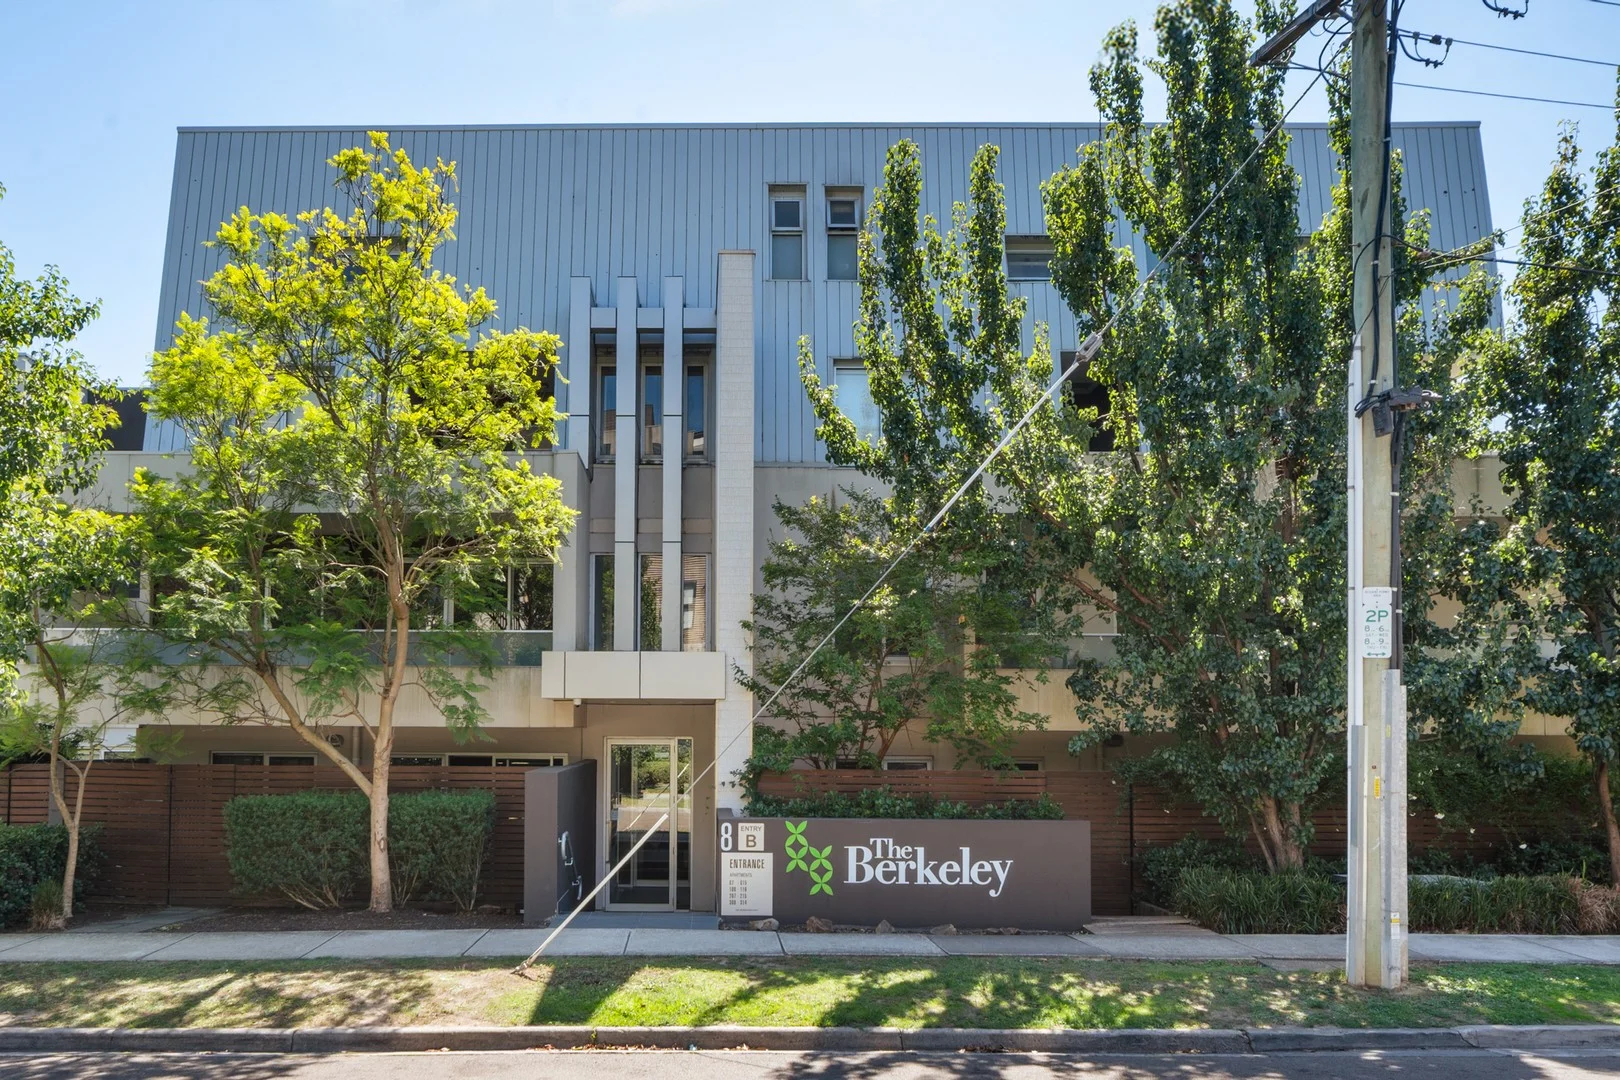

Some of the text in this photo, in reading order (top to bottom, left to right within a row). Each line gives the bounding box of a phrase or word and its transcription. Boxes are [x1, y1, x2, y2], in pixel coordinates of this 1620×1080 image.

[1366, 610, 1388, 622] 2P
[721, 822, 732, 851] 8
[746, 834, 757, 848] B
[870, 838, 913, 859] The
[729, 858, 765, 869] ENTRANCE
[843, 845, 1014, 897] Berkeley
